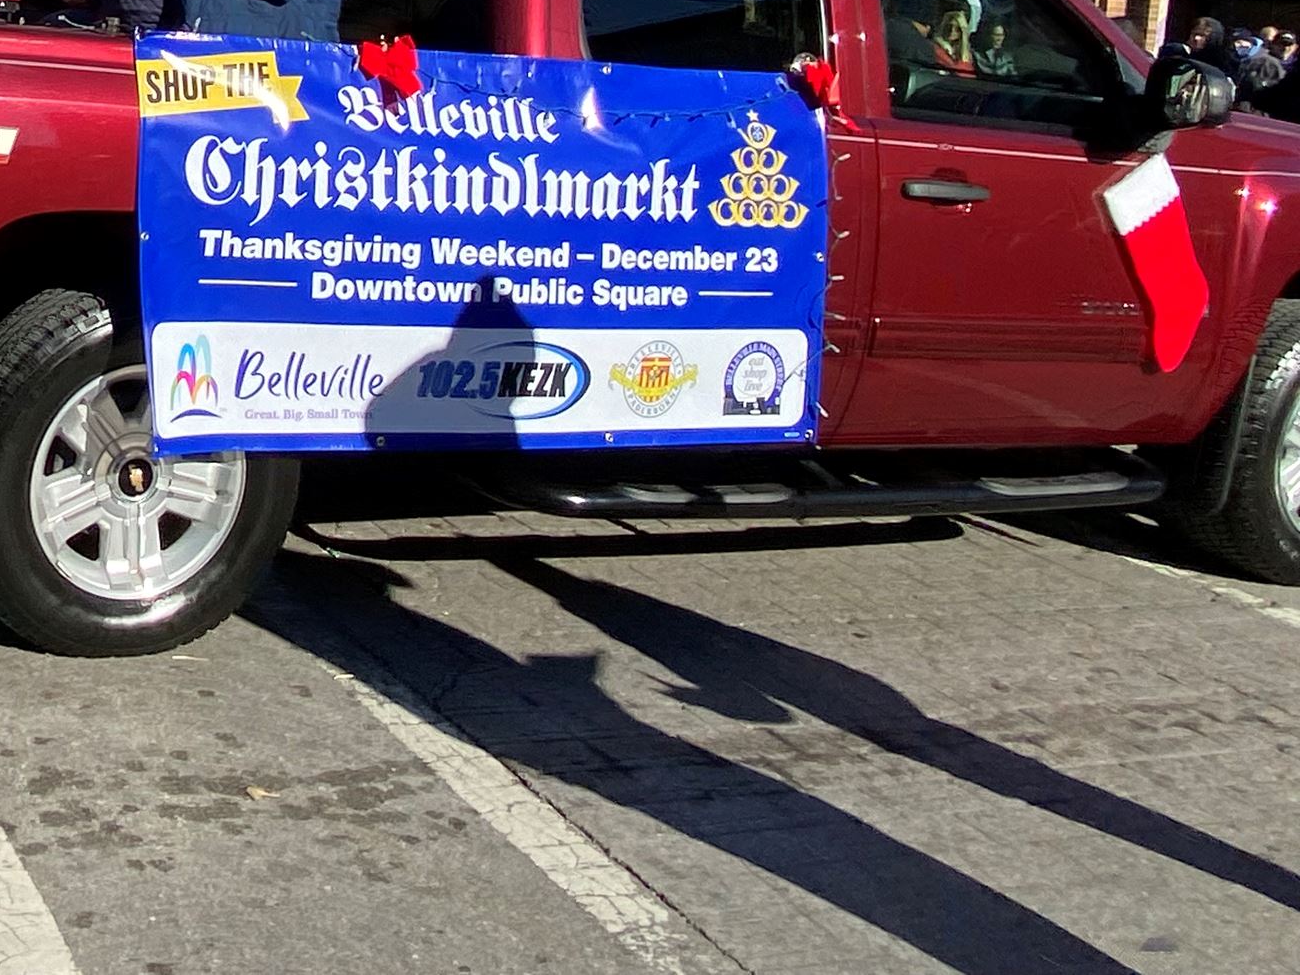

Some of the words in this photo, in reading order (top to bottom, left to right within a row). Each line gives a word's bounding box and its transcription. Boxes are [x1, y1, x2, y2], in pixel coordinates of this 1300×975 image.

[146, 64, 215, 103] SHOP
[223, 61, 271, 99] THE
[337, 85, 561, 144] Belleville
[184, 133, 700, 226] Christkindlmarkt
[199, 229, 422, 269] Thanksgiving
[430, 237, 571, 269] Weekend
[601, 242, 738, 273] December
[745, 247, 779, 273] 23
[311, 271, 483, 303] Downtown
[492, 277, 585, 306] Public
[592, 279, 689, 312] Square
[234, 348, 385, 402] Belleville
[307, 409, 339, 419] Small
